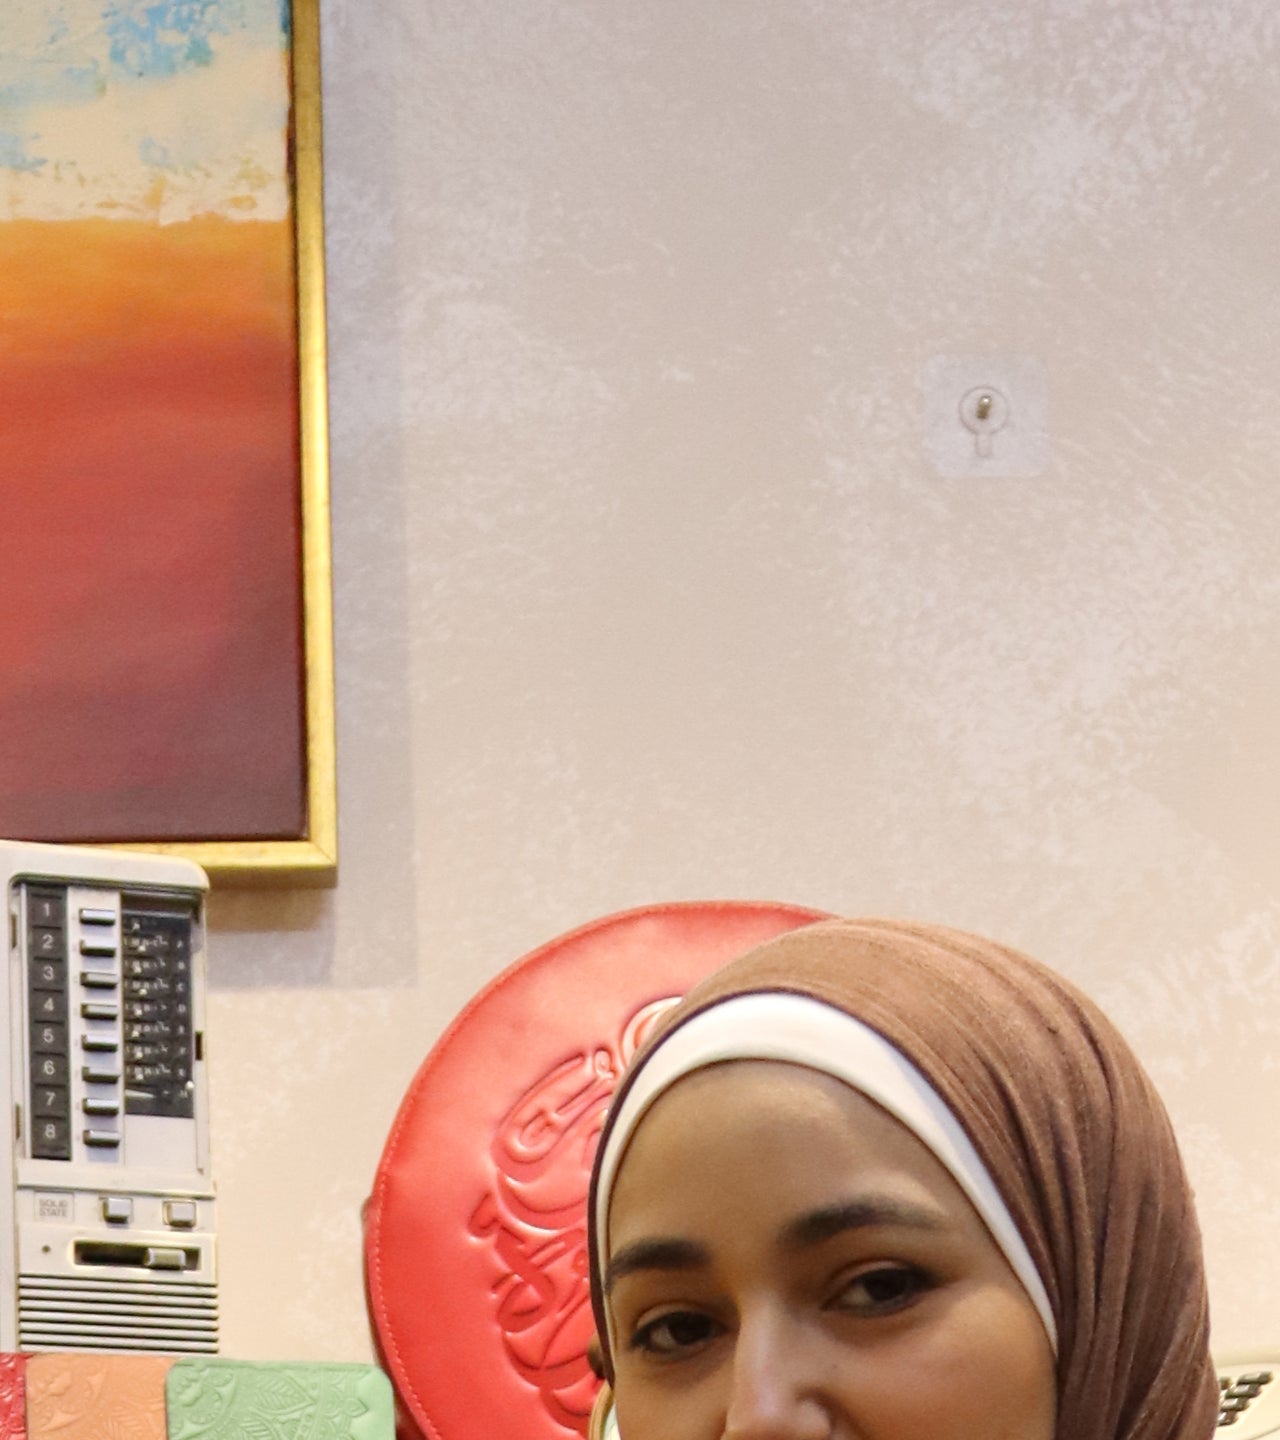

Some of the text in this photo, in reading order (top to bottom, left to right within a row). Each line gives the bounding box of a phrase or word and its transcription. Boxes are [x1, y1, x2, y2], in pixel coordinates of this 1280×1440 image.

[43, 902, 50, 917] 1
[42, 934, 53, 949] 2
[43, 965, 54, 980] 3
[44, 998, 54, 1011] 4
[43, 1028, 54, 1043] 5
[44, 1060, 55, 1075] 6
[45, 1092, 56, 1106] 7
[45, 1123, 56, 1138] 8
[39, 1208, 68, 1217] STATE
